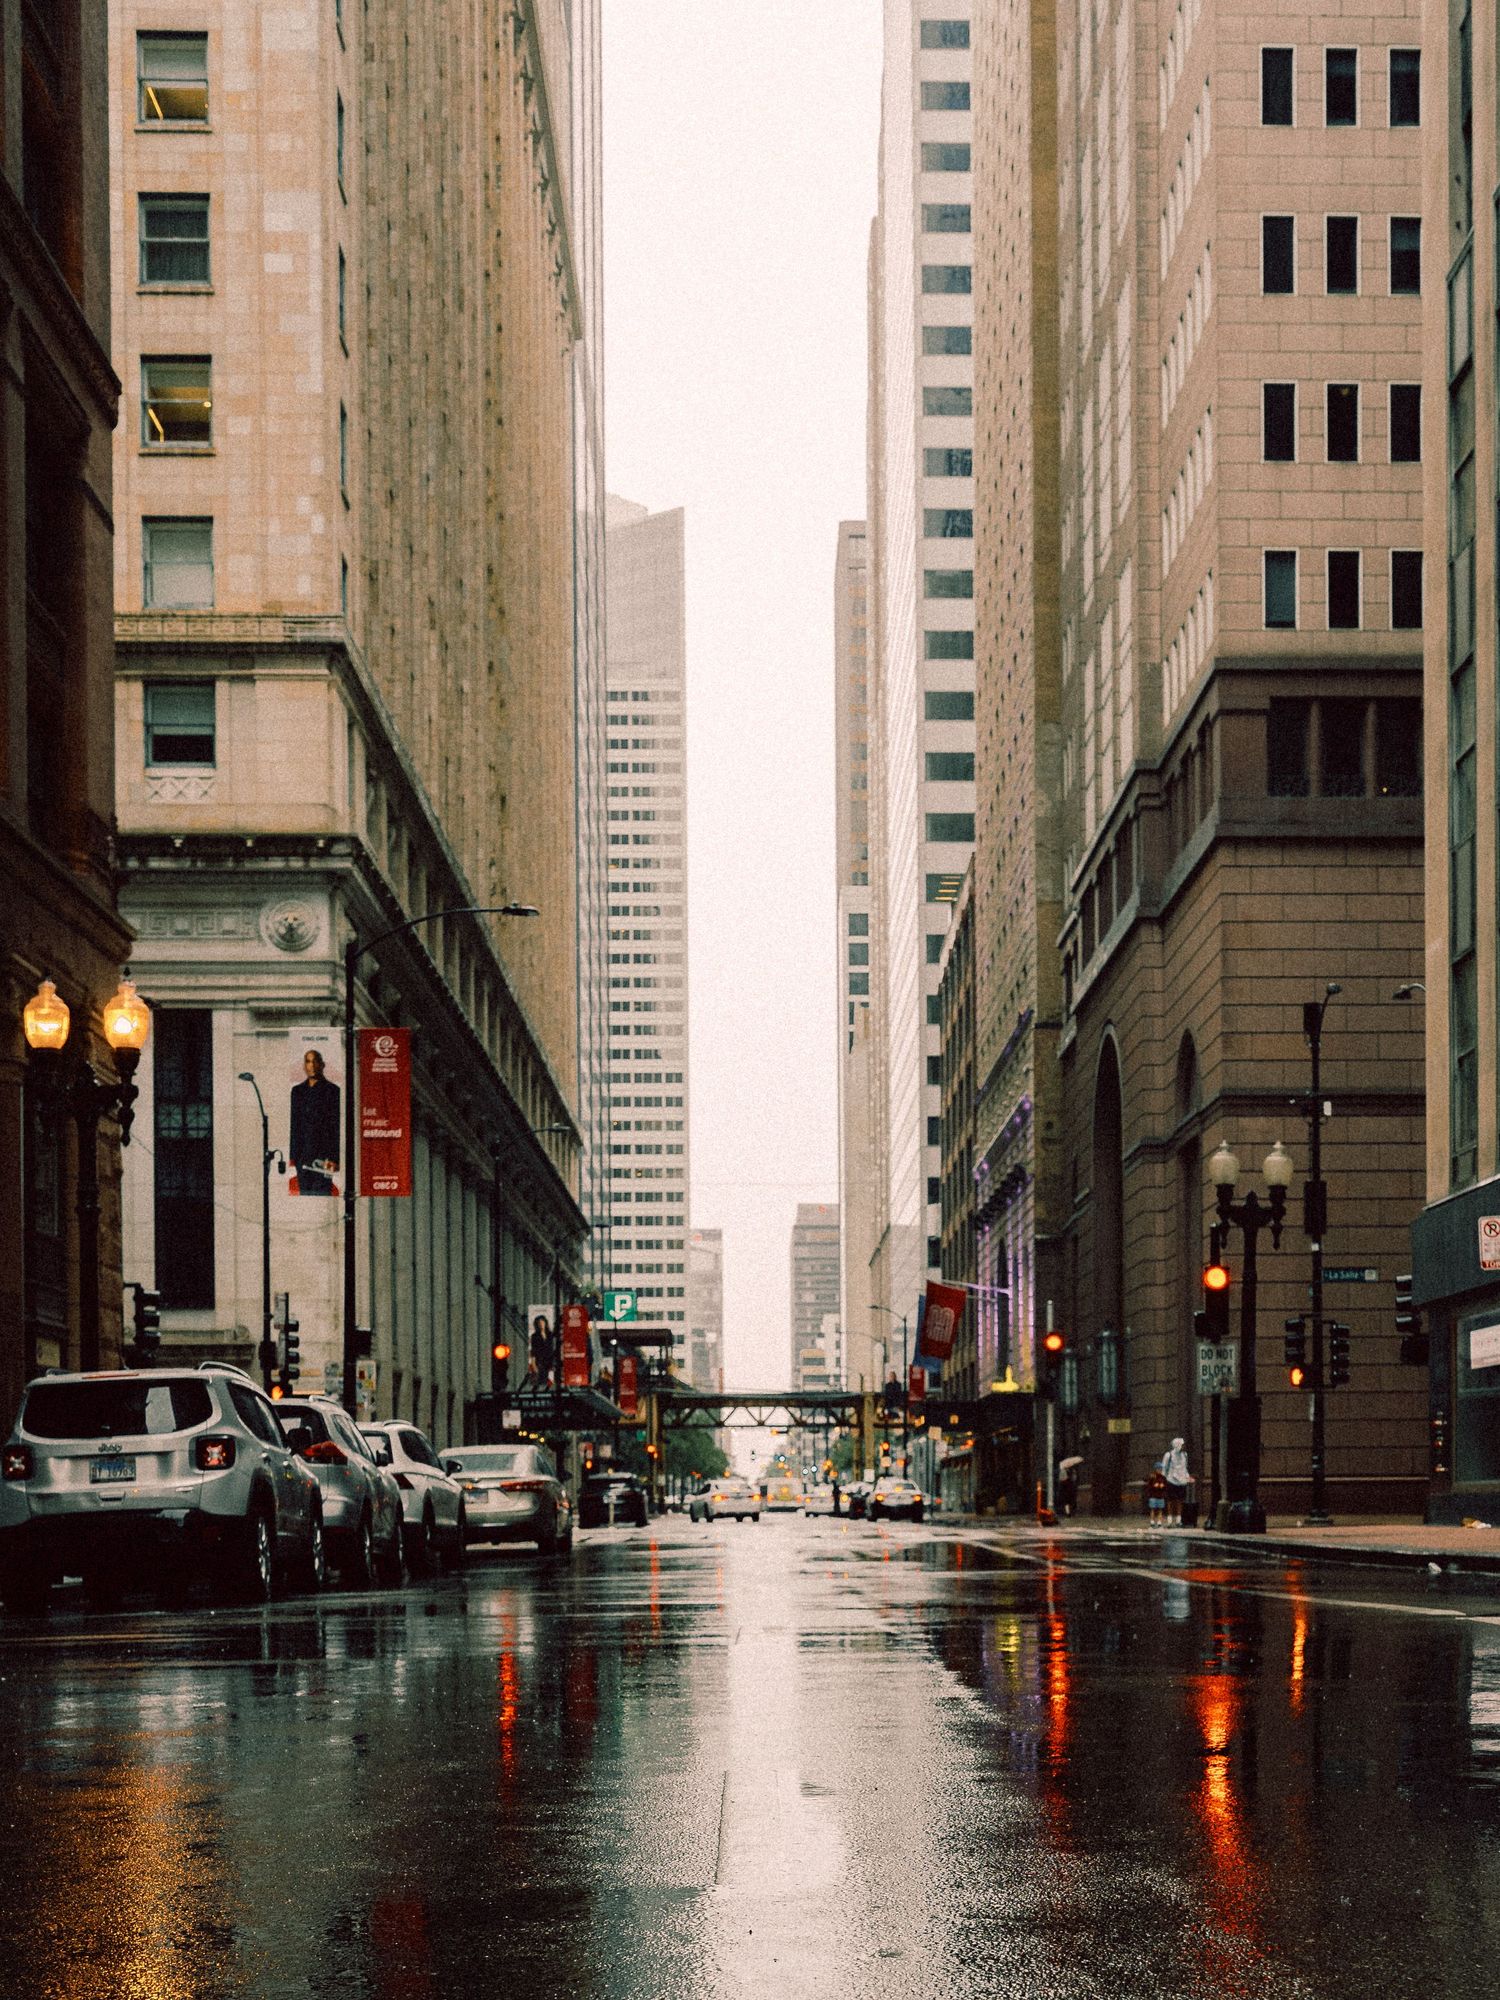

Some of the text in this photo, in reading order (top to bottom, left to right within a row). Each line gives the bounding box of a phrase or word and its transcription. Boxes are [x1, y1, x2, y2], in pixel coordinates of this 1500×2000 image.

[362, 1118, 389, 1127] music
[362, 1128, 402, 1138] astound
[1201, 1349, 1233, 1360] DO NOT
[1201, 1364, 1233, 1378] BLOCK
